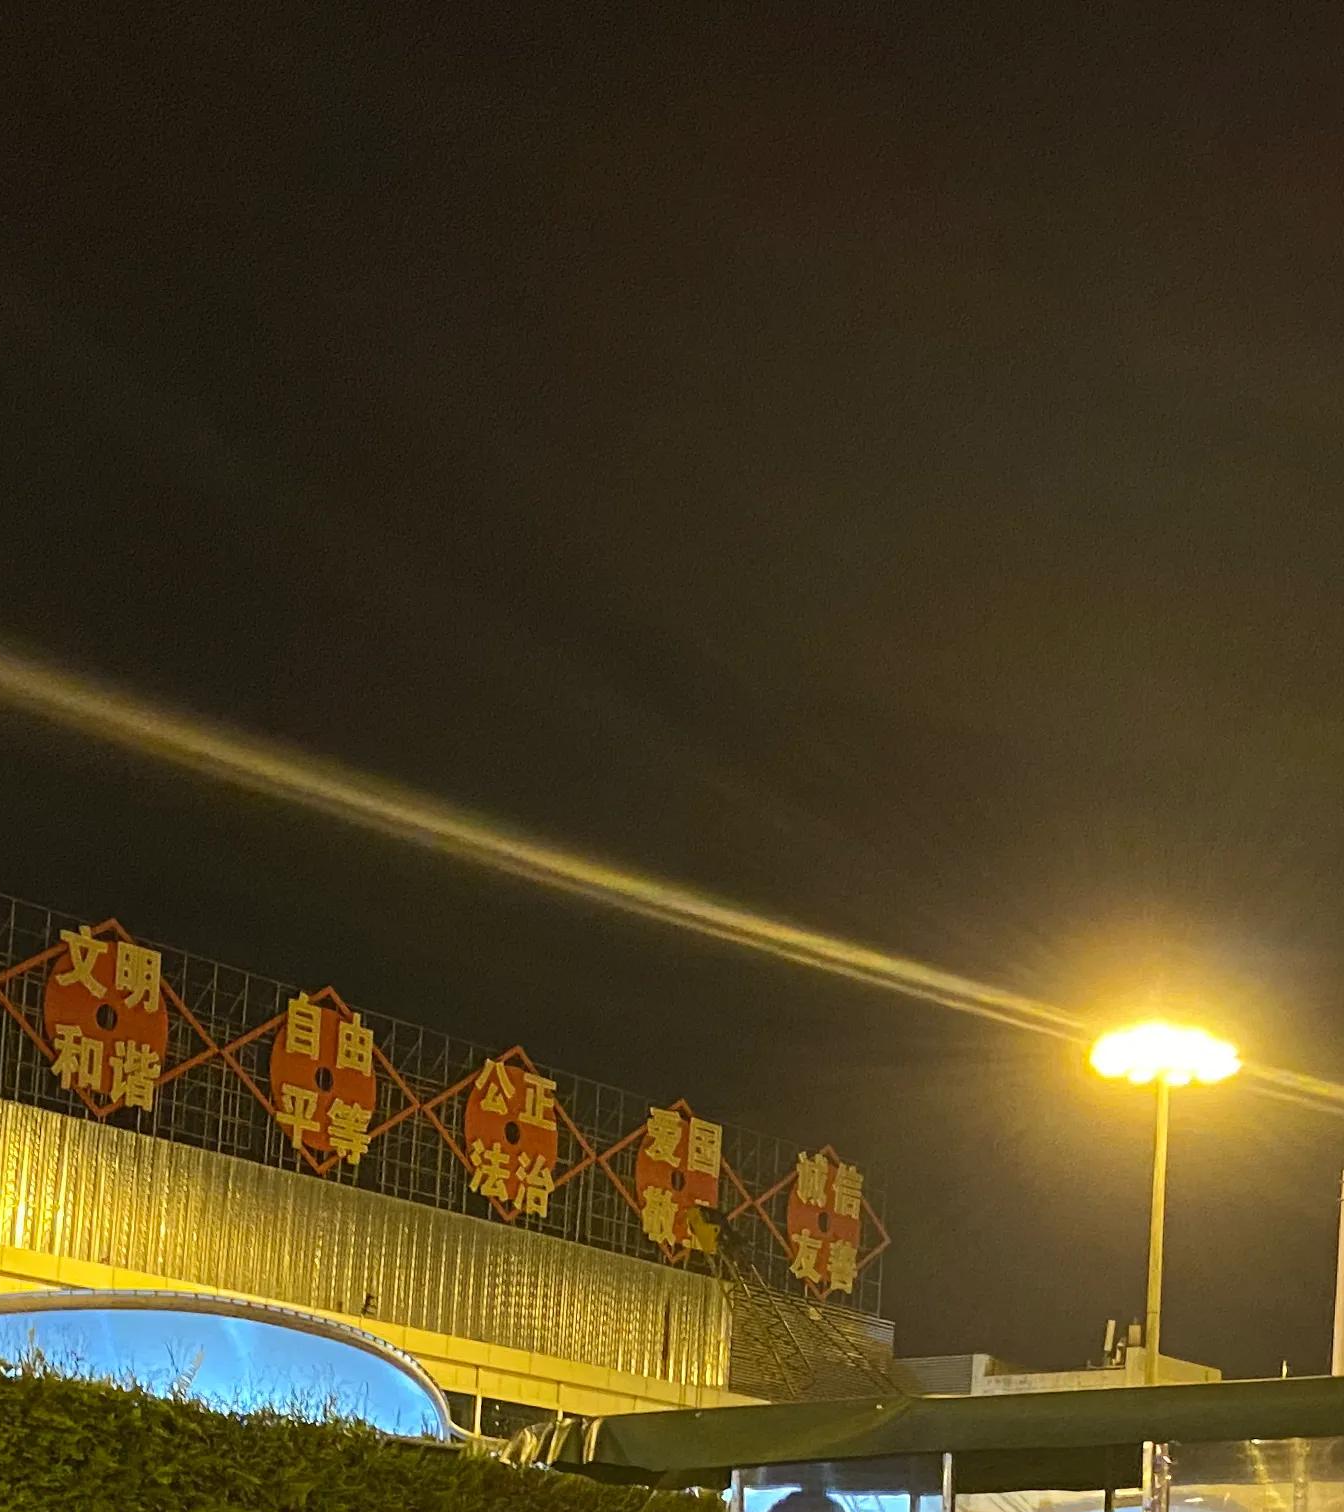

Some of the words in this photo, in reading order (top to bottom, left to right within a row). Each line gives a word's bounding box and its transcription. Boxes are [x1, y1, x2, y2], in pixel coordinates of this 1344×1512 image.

[57, 925, 162, 1012] 文明
[51, 1023, 161, 1112] 和谐
[286, 991, 374, 1077] 自由
[276, 1083, 372, 1165] 平等
[475, 1058, 557, 1131] 公正
[468, 1138, 554, 1218] 法治
[645, 1107, 723, 1178] 爱国
[642, 1185, 718, 1254] 敬
[797, 1151, 865, 1219] 诚信
[789, 1229, 858, 1294] 友善
